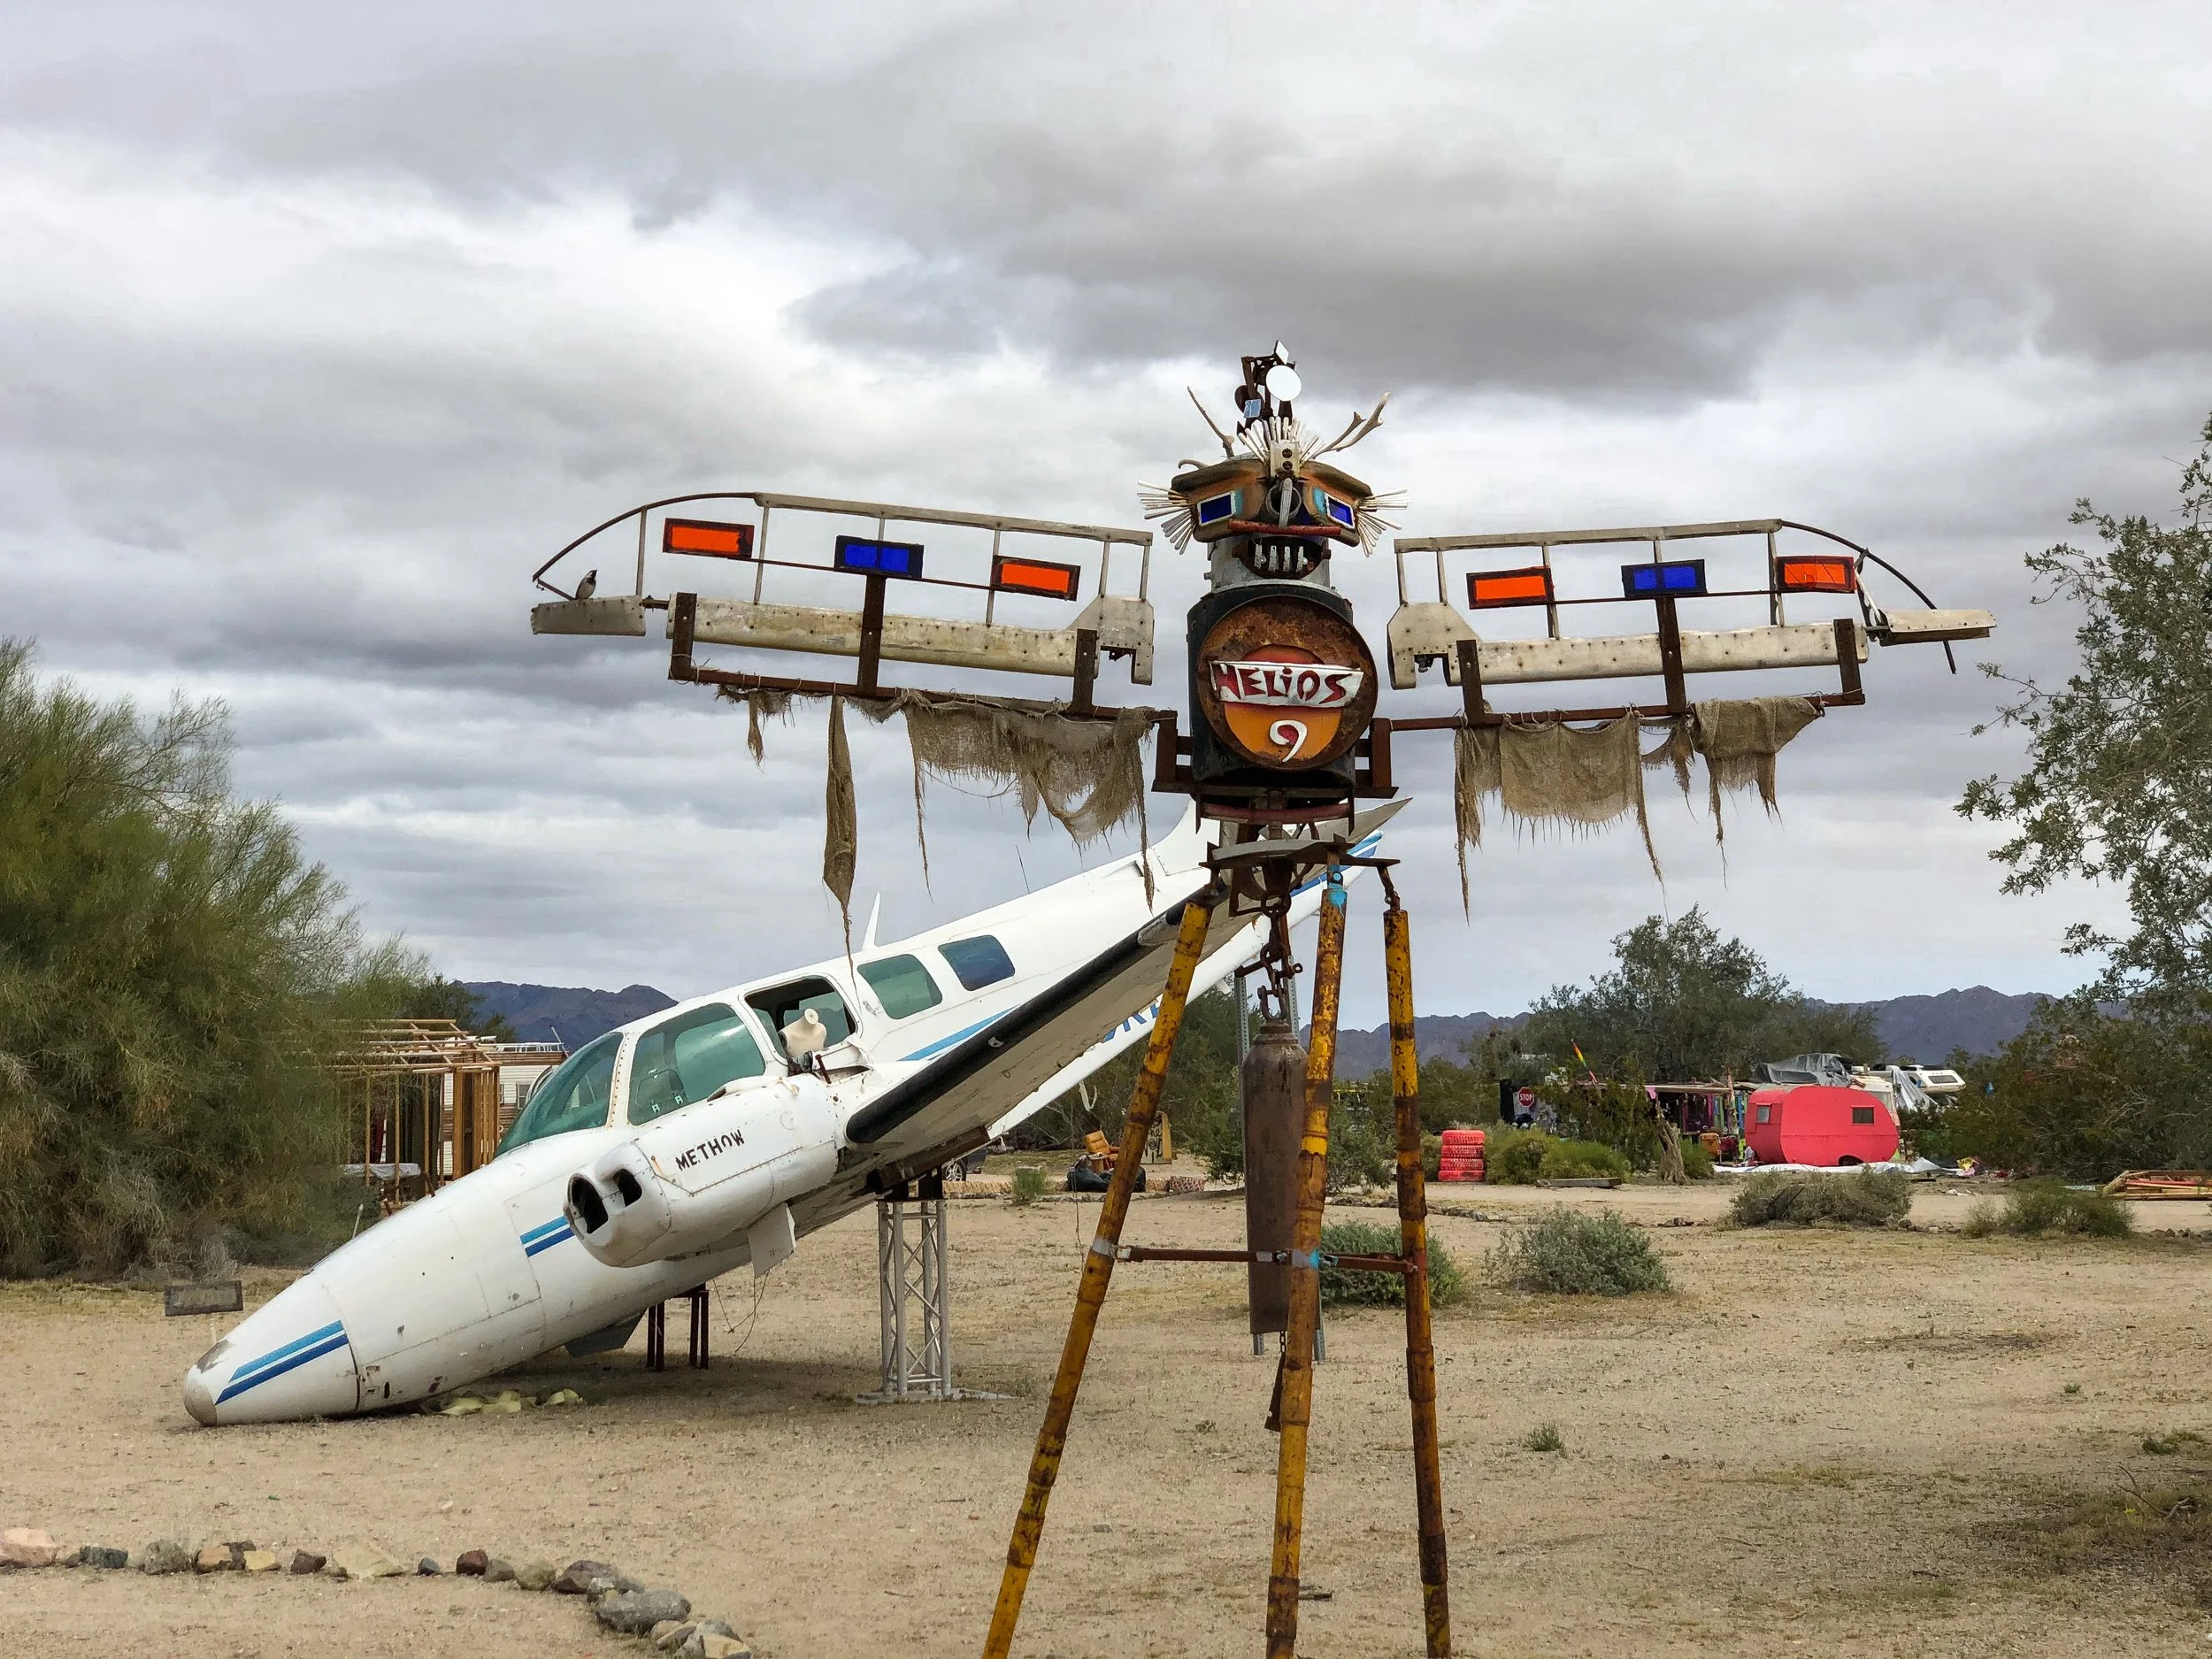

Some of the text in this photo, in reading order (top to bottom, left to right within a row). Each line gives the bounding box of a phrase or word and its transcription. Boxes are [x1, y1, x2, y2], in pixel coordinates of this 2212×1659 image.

[1269, 719, 1308, 763] 9
[1519, 1093, 1532, 1102] STOP
[675, 1129, 745, 1171] METHOW
